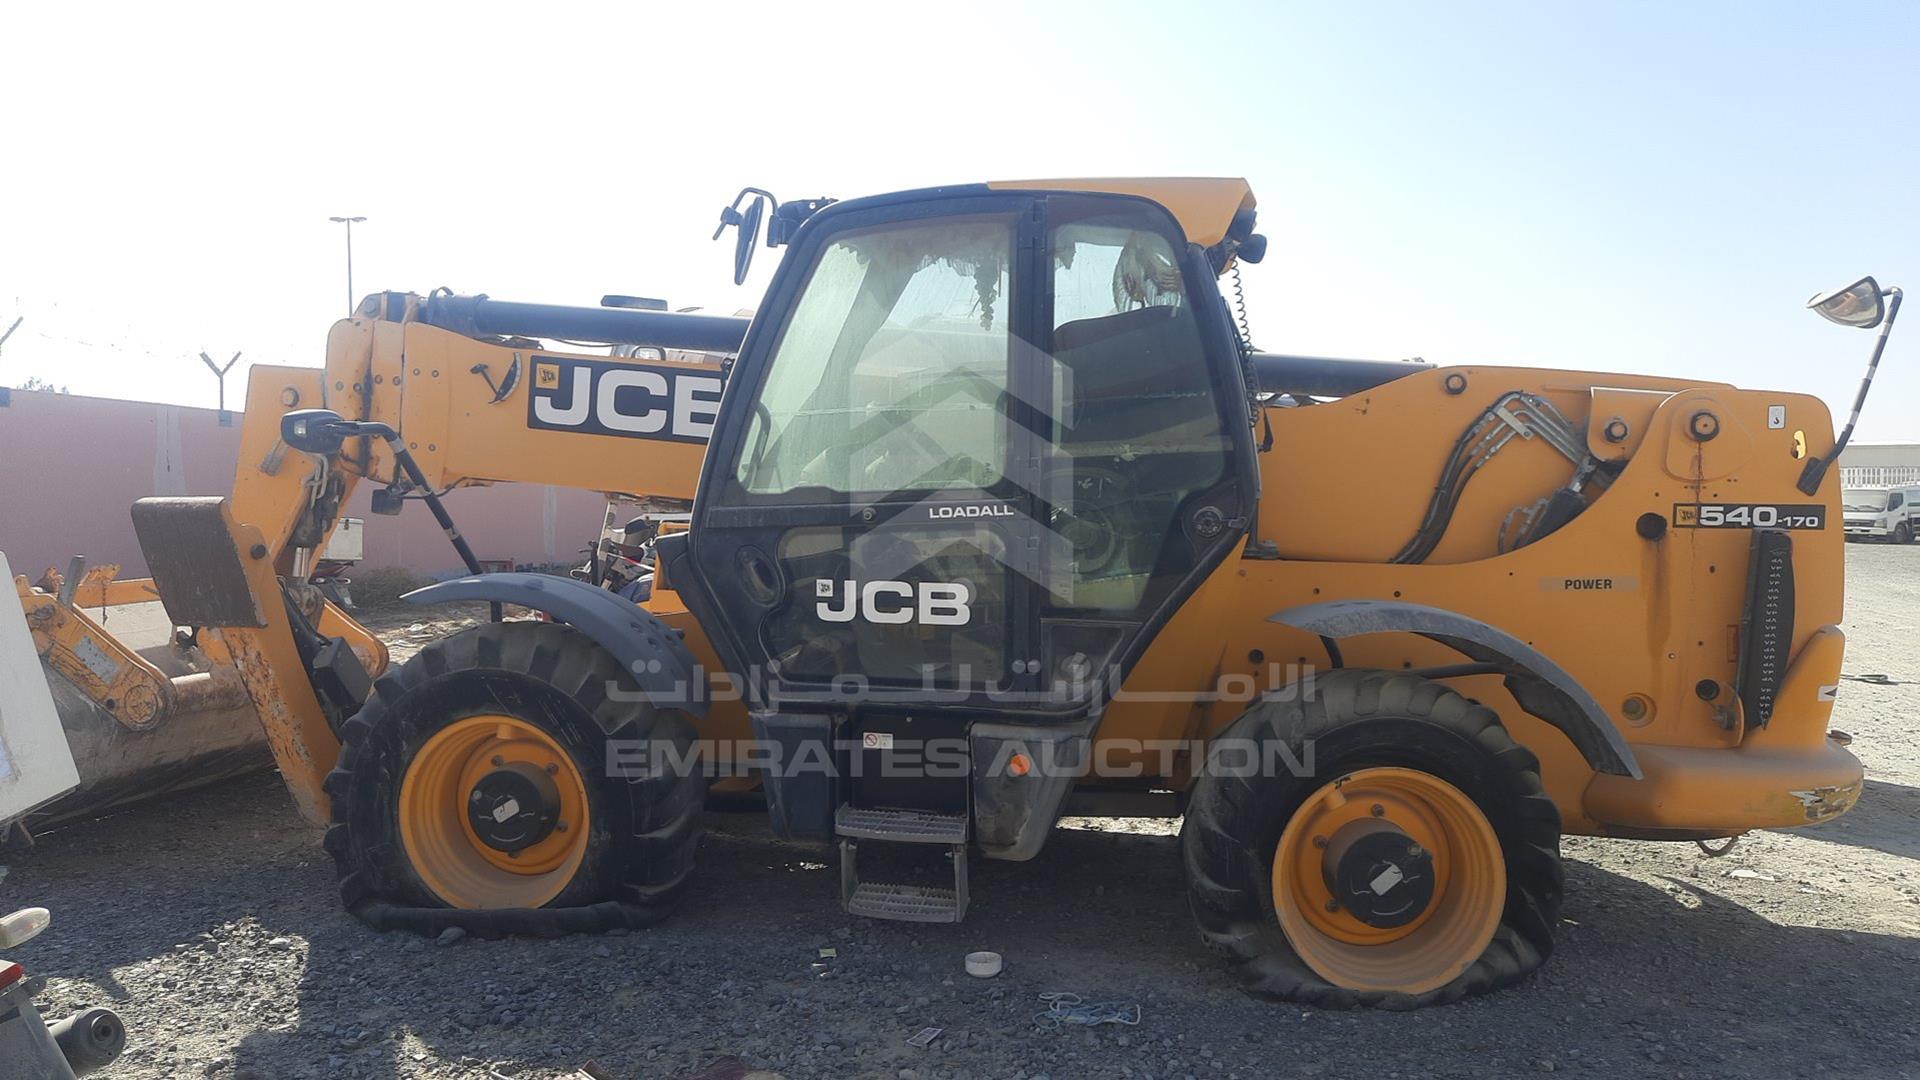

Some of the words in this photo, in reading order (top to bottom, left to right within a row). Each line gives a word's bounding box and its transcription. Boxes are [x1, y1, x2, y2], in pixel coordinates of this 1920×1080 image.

[929, 505, 1014, 519] LOADALL
[1564, 578, 1613, 590] POWER
[816, 580, 971, 626] JCB
